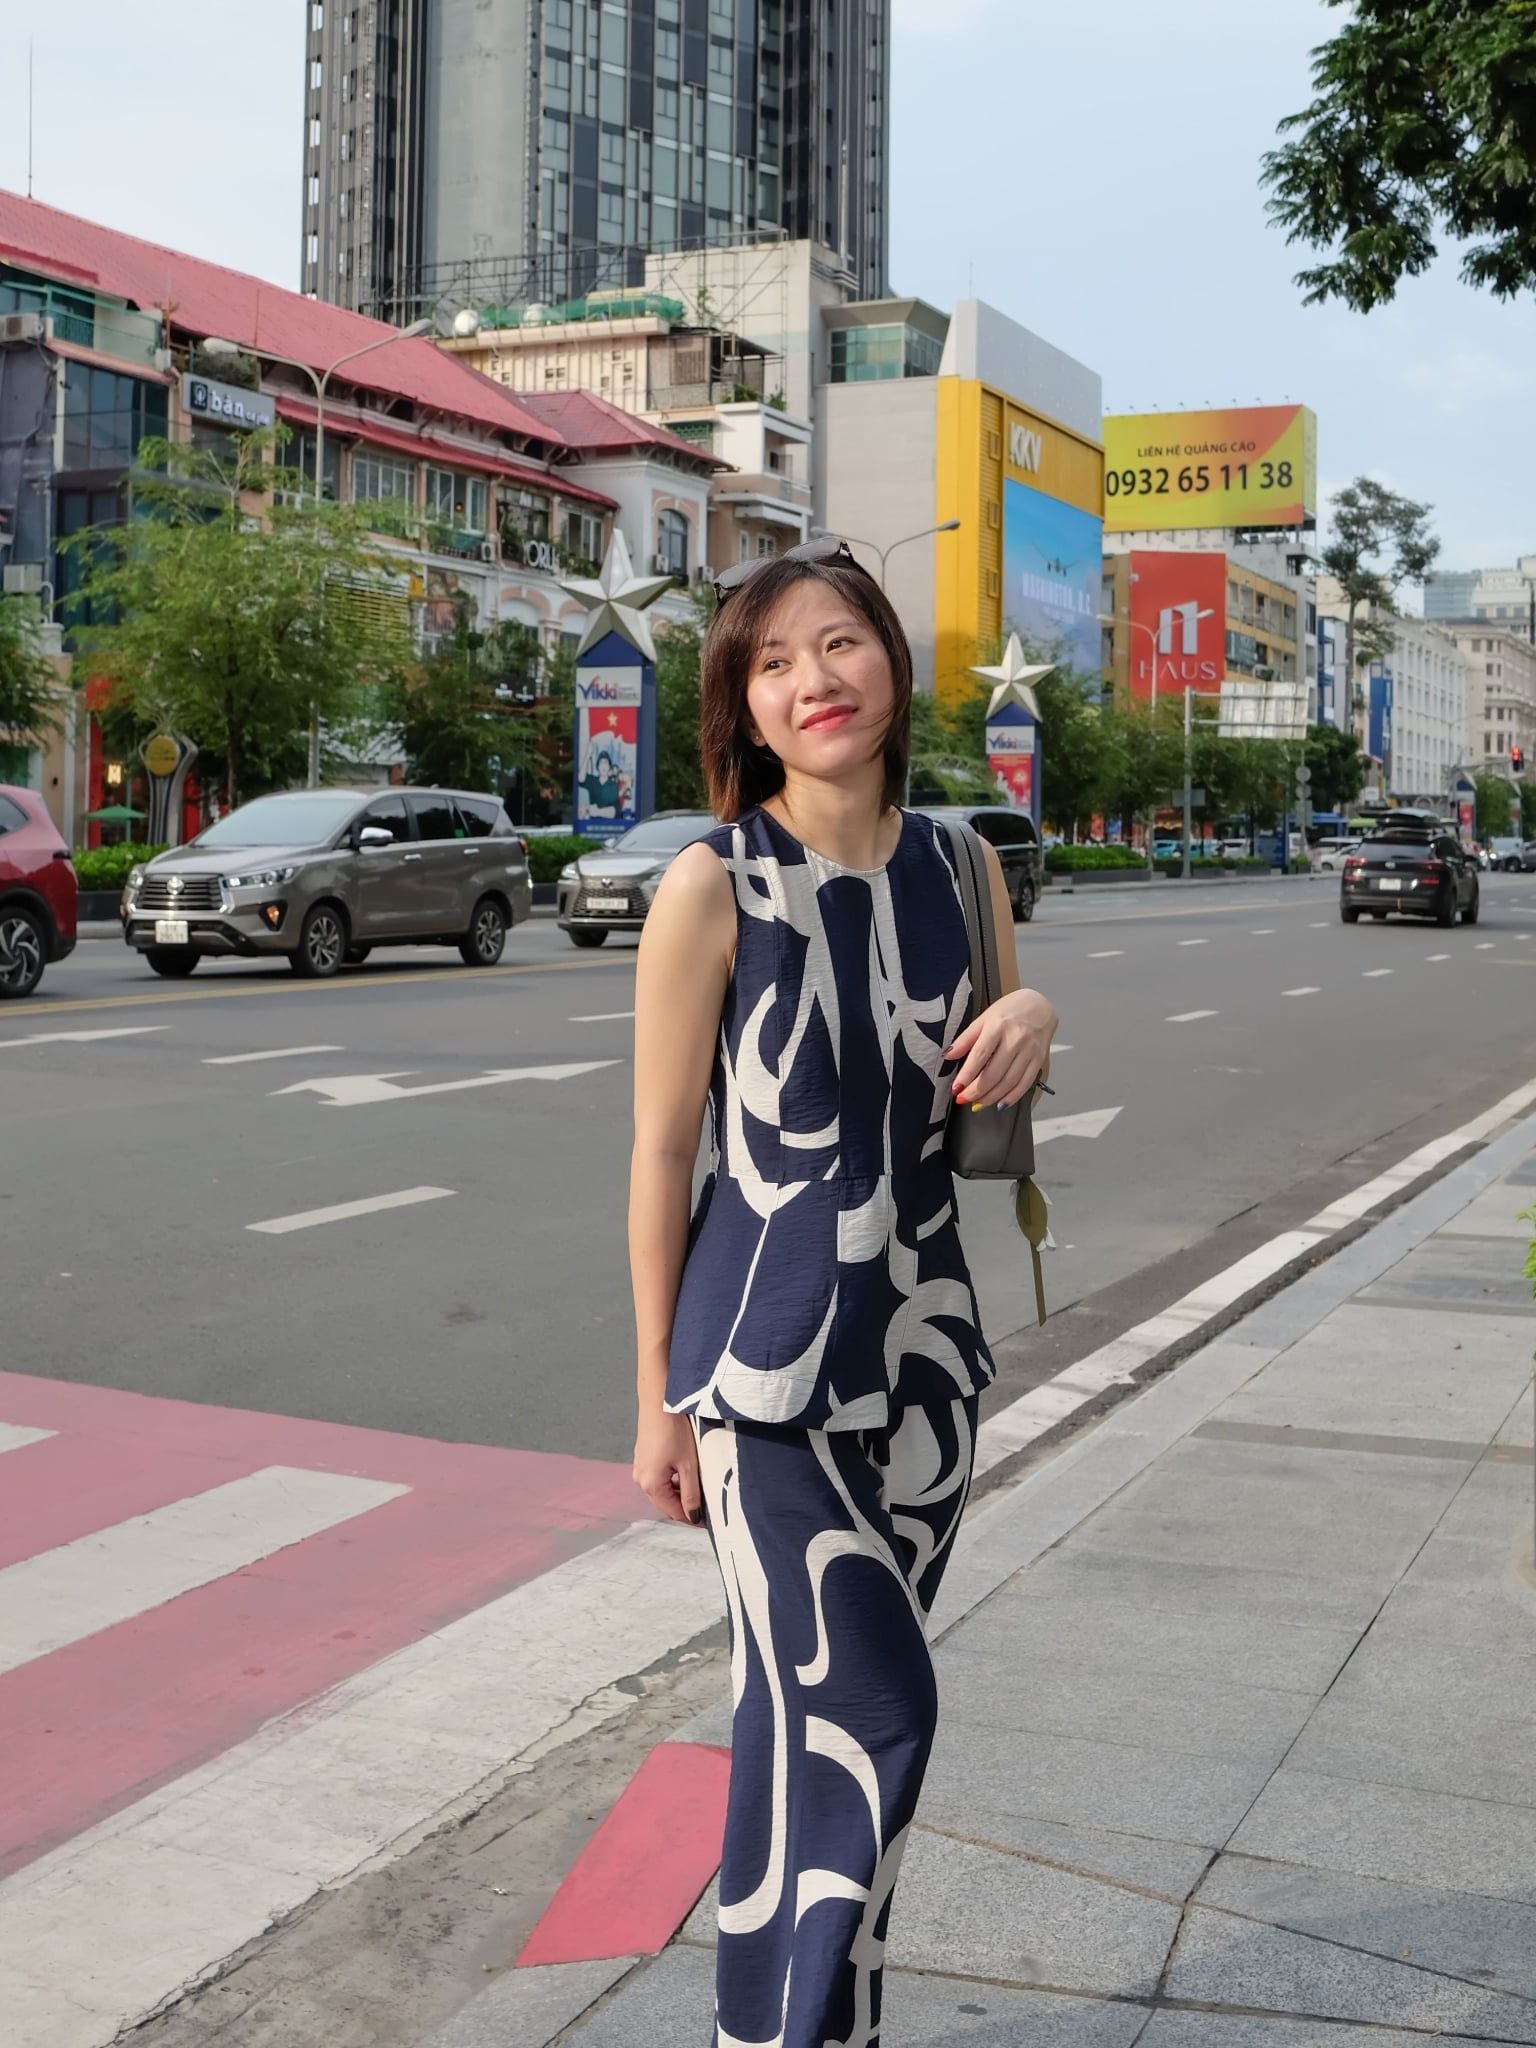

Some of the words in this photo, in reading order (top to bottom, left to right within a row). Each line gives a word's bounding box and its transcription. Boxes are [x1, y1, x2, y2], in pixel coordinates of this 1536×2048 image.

[1010, 421, 1041, 474] KKV
[1138, 445, 1162, 457] LIÊN
[1184, 442, 1227, 455] QUẢNG
[1231, 441, 1256, 452] CÁO
[1106, 467, 1169, 497] 0932
[1178, 465, 1209, 492] 65
[1220, 464, 1247, 490] 11
[1260, 461, 1293, 489] 38
[1139, 660, 1217, 680] HAUS
[578, 673, 617, 700] Vikki
